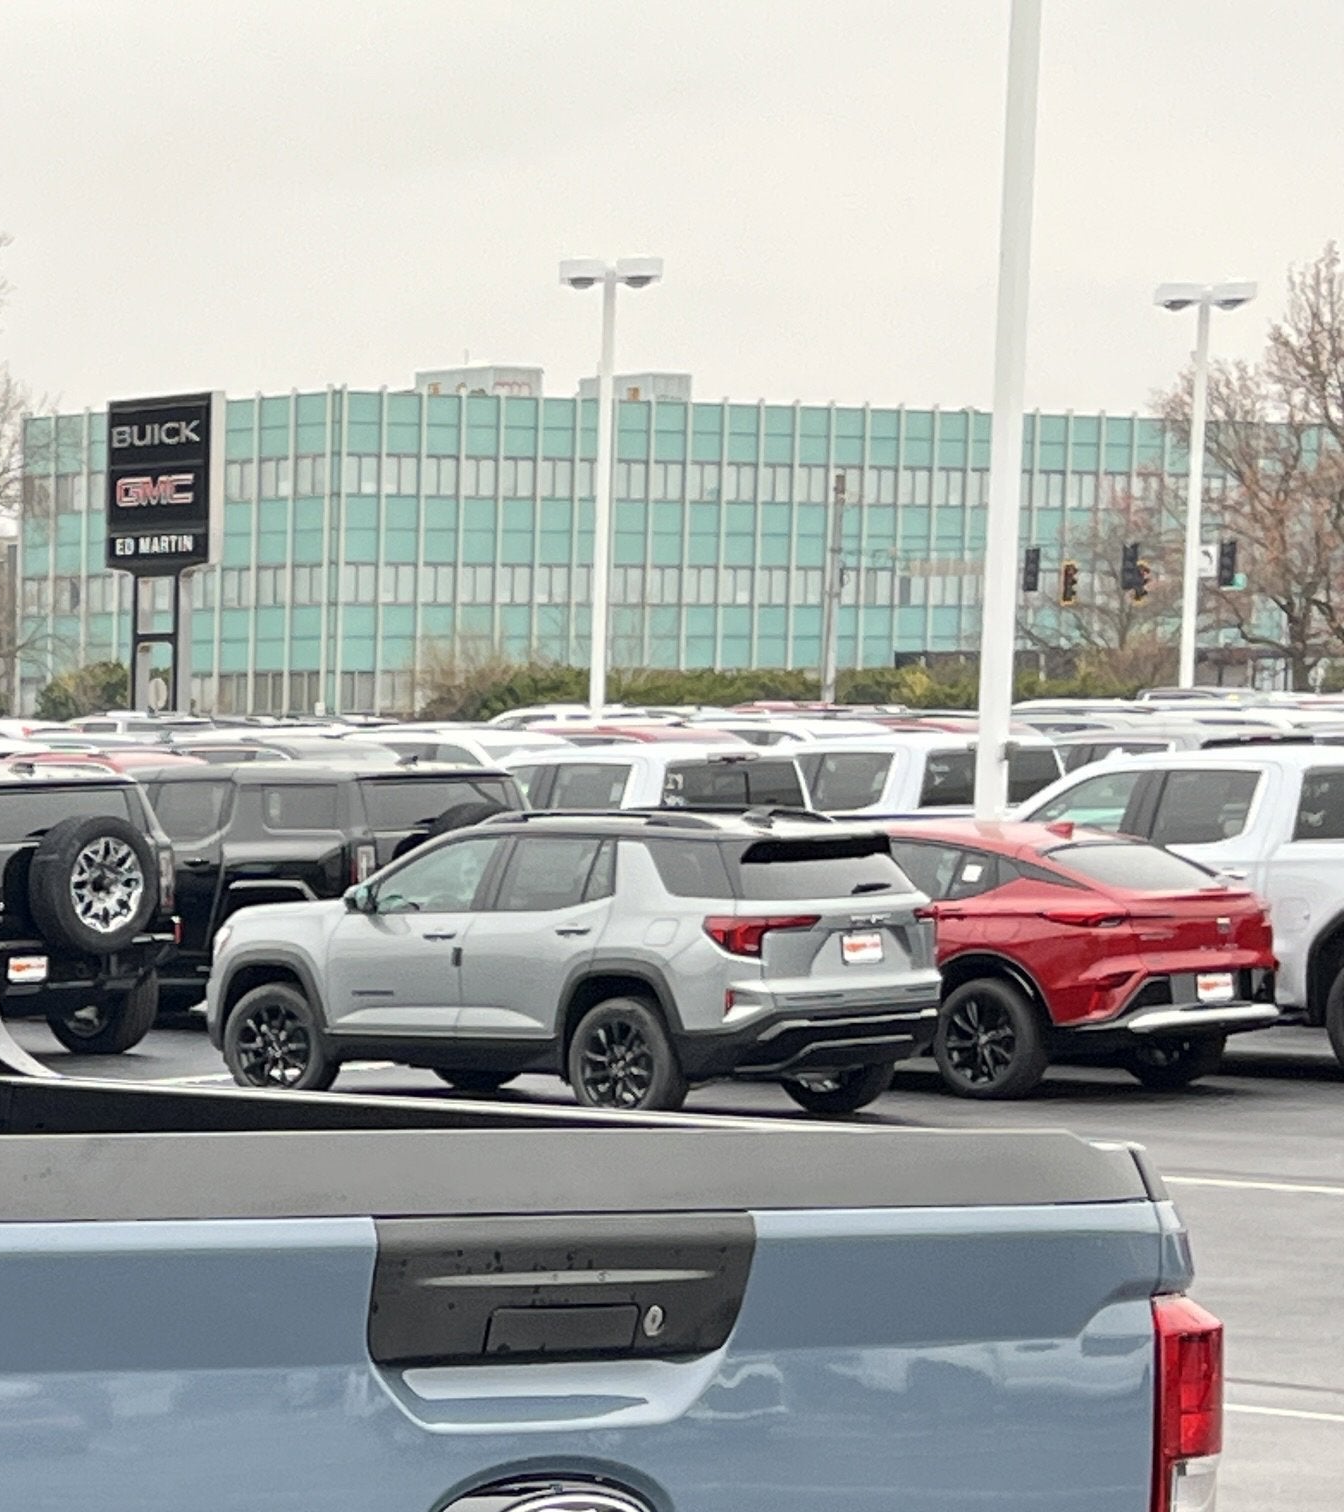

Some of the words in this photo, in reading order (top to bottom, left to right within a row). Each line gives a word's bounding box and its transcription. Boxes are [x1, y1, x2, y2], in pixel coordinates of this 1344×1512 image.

[111, 420, 201, 448] BUICK
[115, 473, 196, 508] GMC
[115, 538, 135, 556] ED
[139, 534, 194, 554] MARTIN
